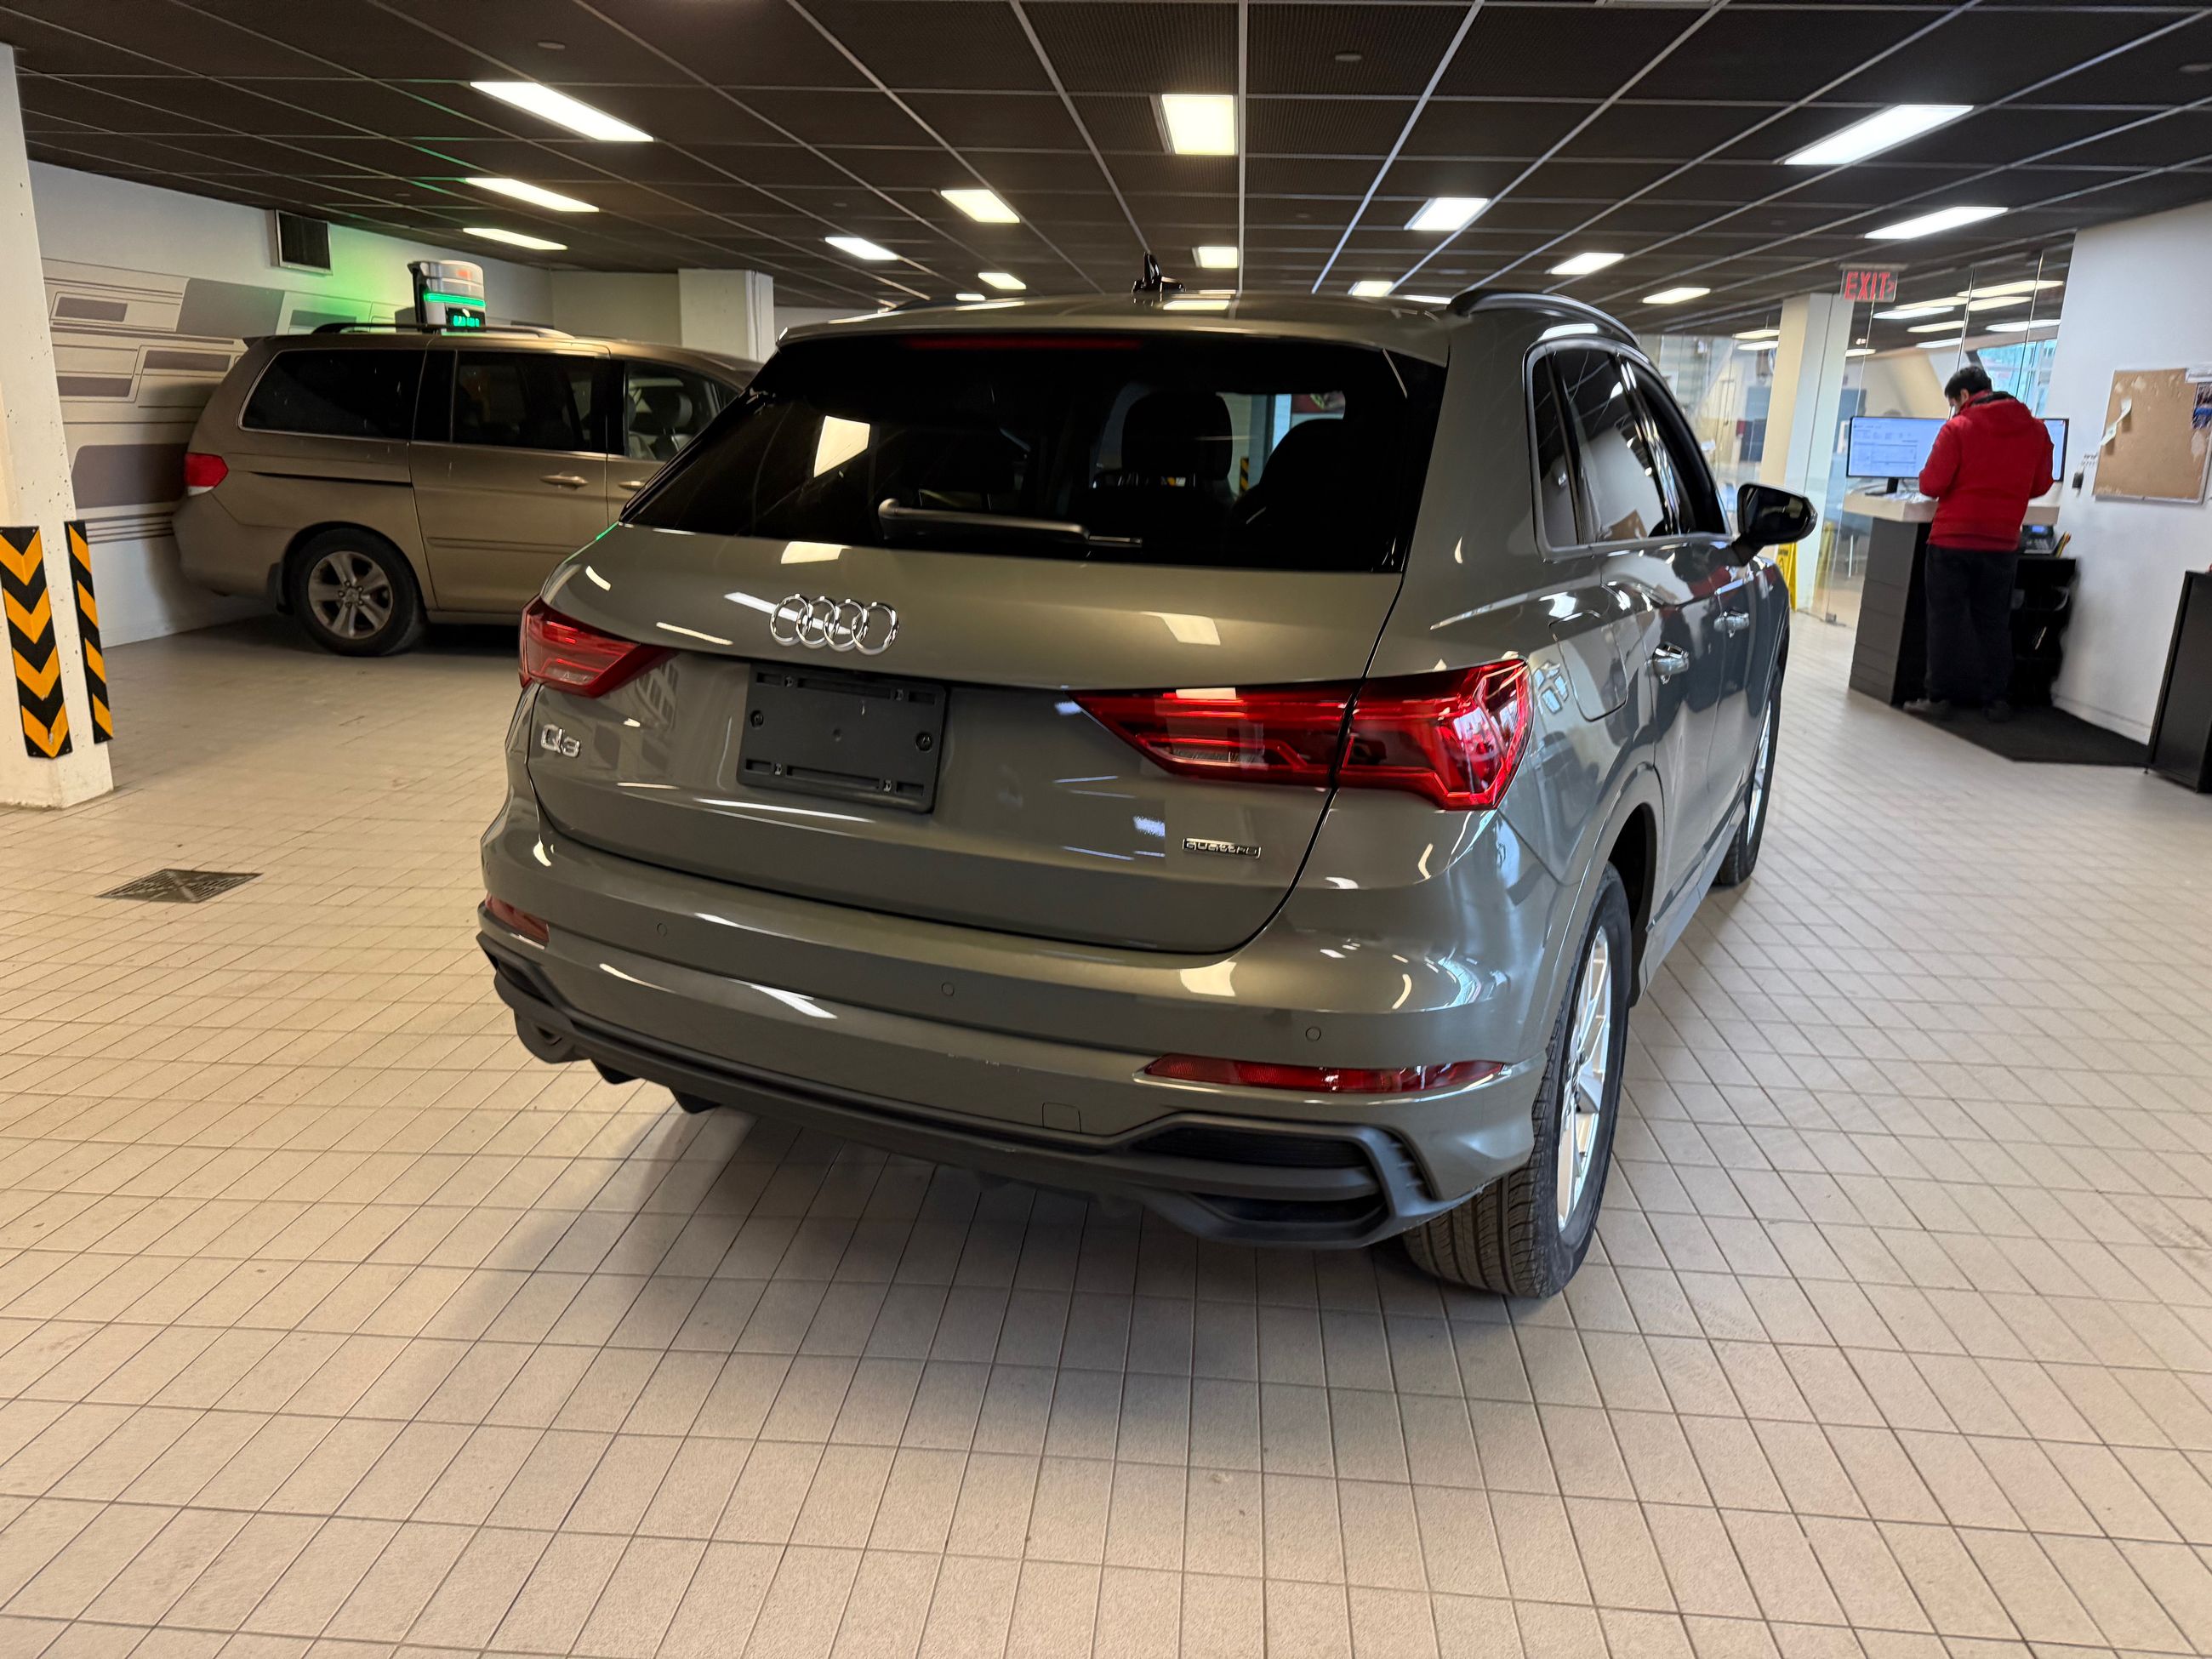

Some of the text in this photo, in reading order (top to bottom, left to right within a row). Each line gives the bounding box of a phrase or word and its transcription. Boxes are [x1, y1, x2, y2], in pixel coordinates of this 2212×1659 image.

[1844, 271, 1890, 299] EXIT
[541, 724, 580, 757] Q3
[1185, 839, 1258, 856] quattro
